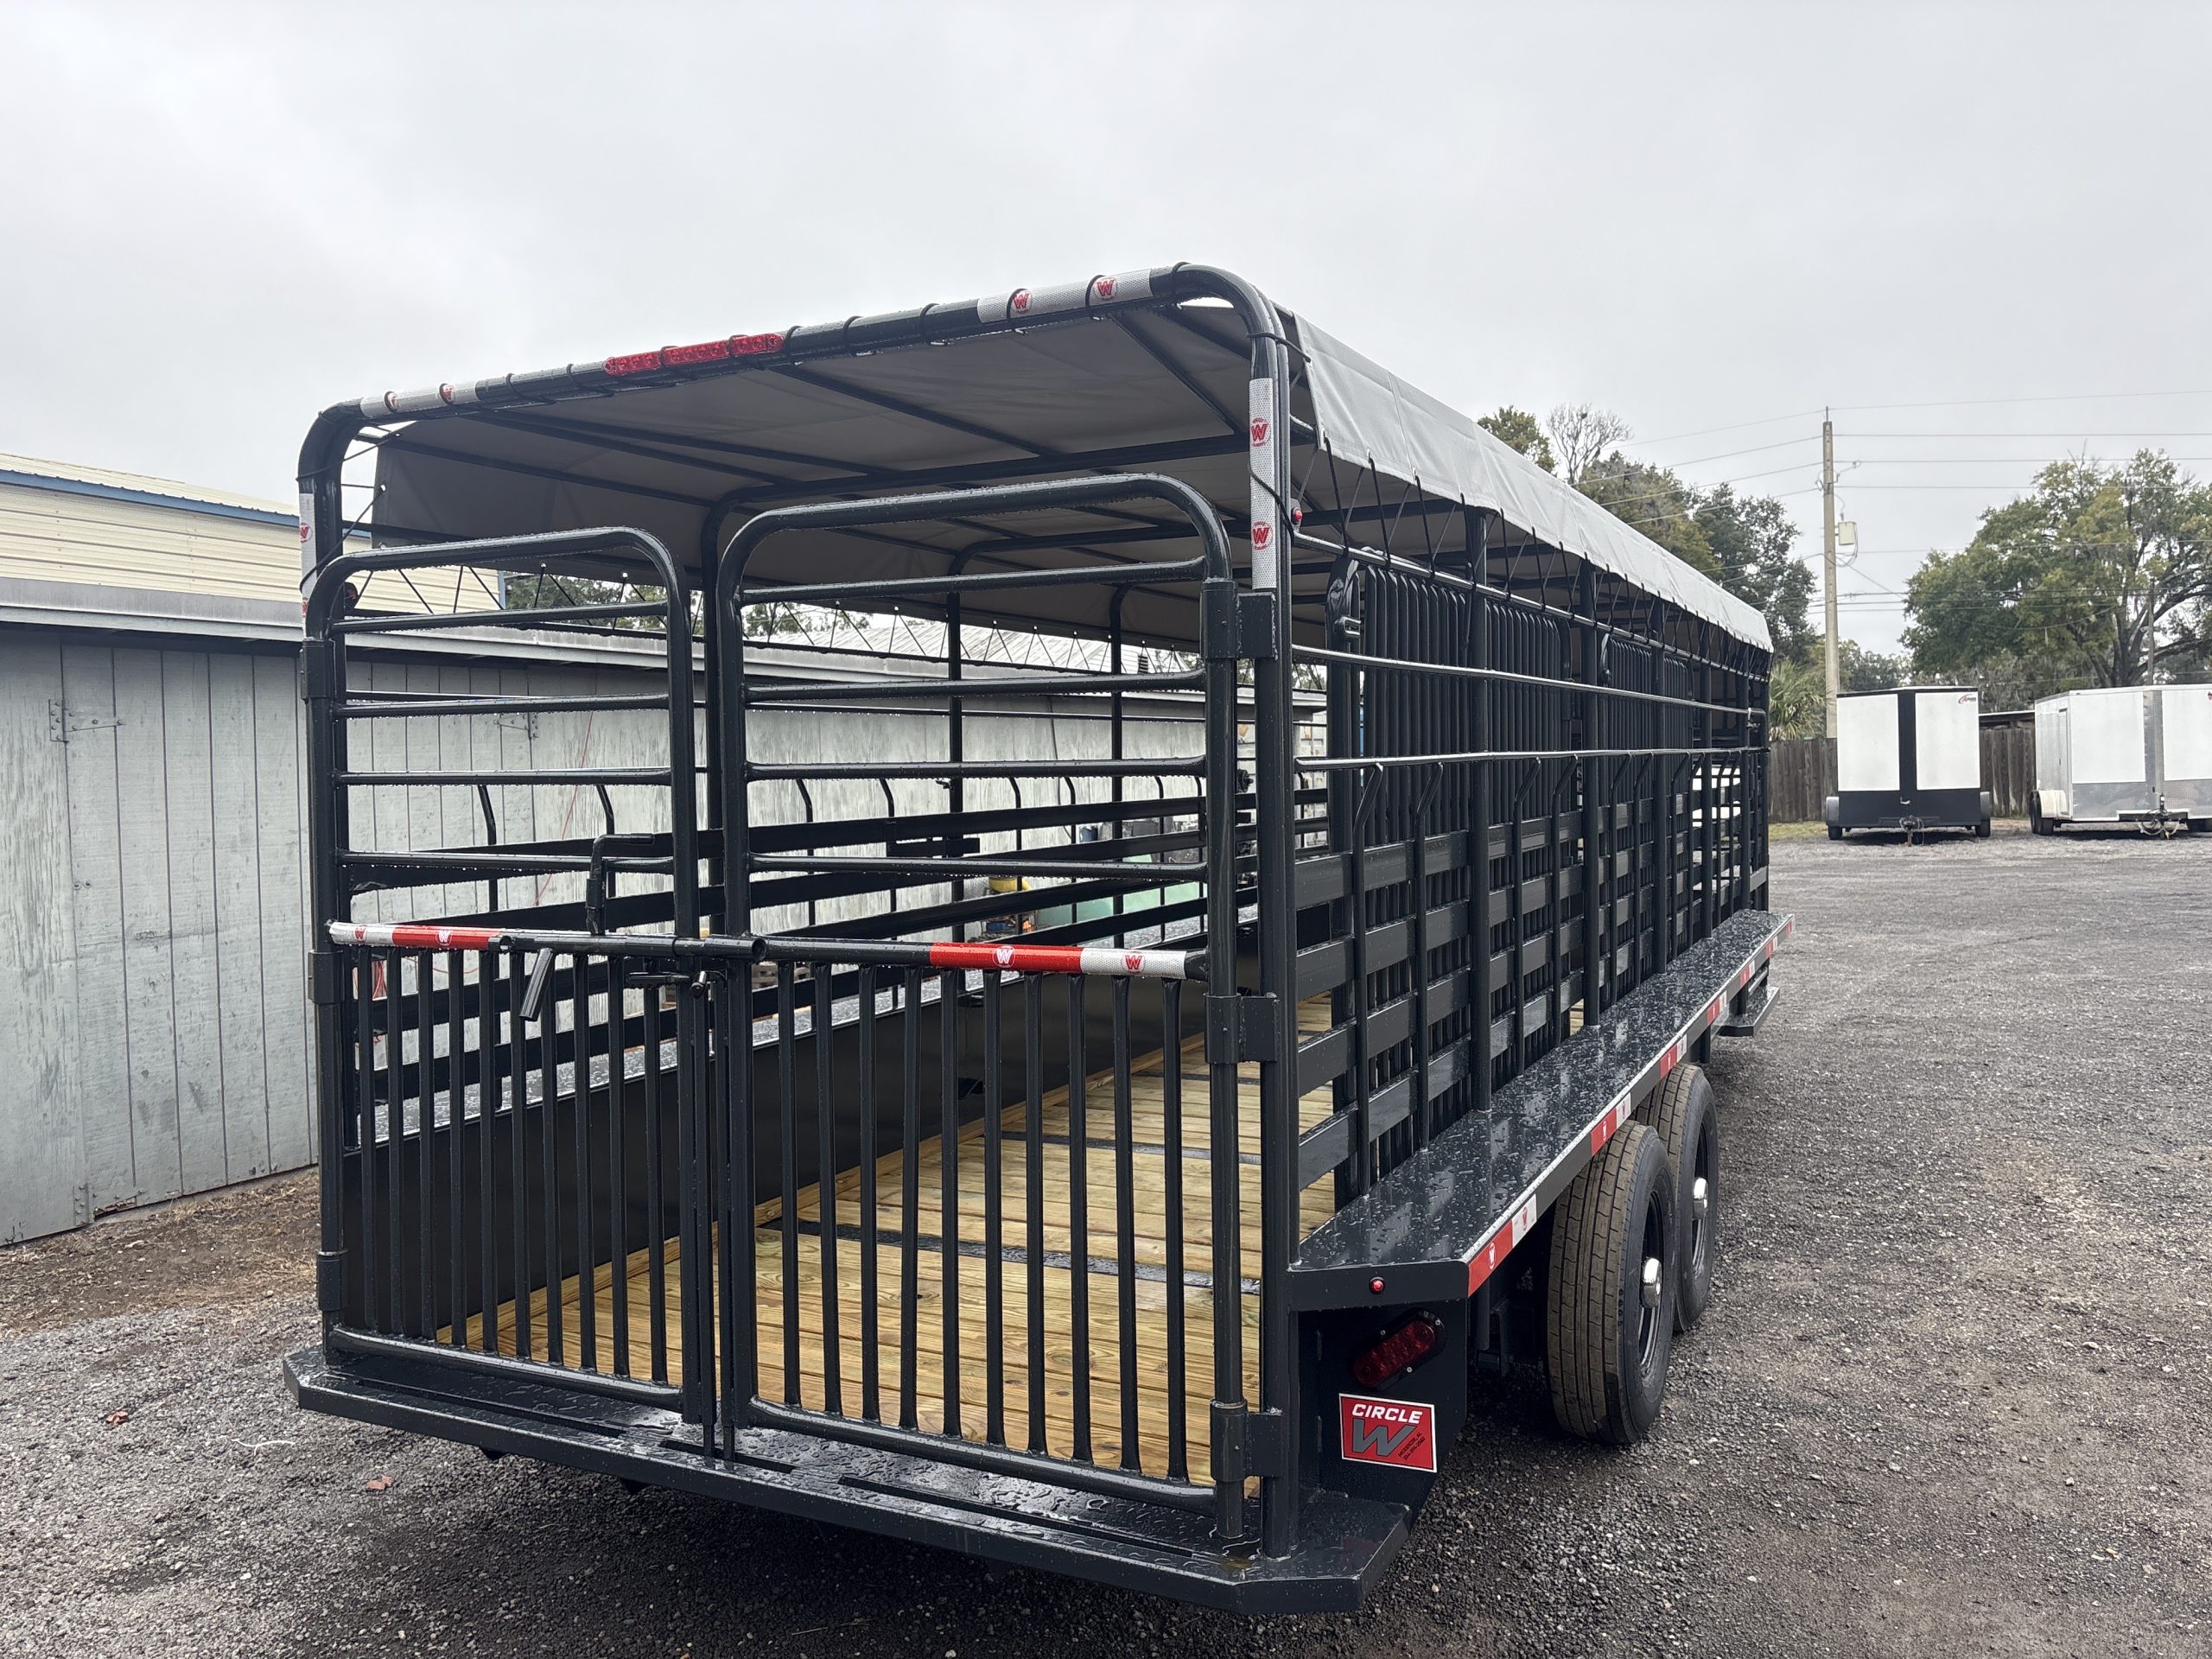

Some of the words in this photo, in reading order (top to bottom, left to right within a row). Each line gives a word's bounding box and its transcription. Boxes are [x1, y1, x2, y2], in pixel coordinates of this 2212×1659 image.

[1096, 280, 1115, 296] W
[1013, 294, 1029, 309] W
[1251, 423, 1268, 441] W
[1253, 528, 1270, 543] W
[995, 948, 1014, 964] W
[1125, 955, 1142, 969] W
[1352, 1403, 1423, 1424] CIRCLE
[1352, 1417, 1418, 1457] W
